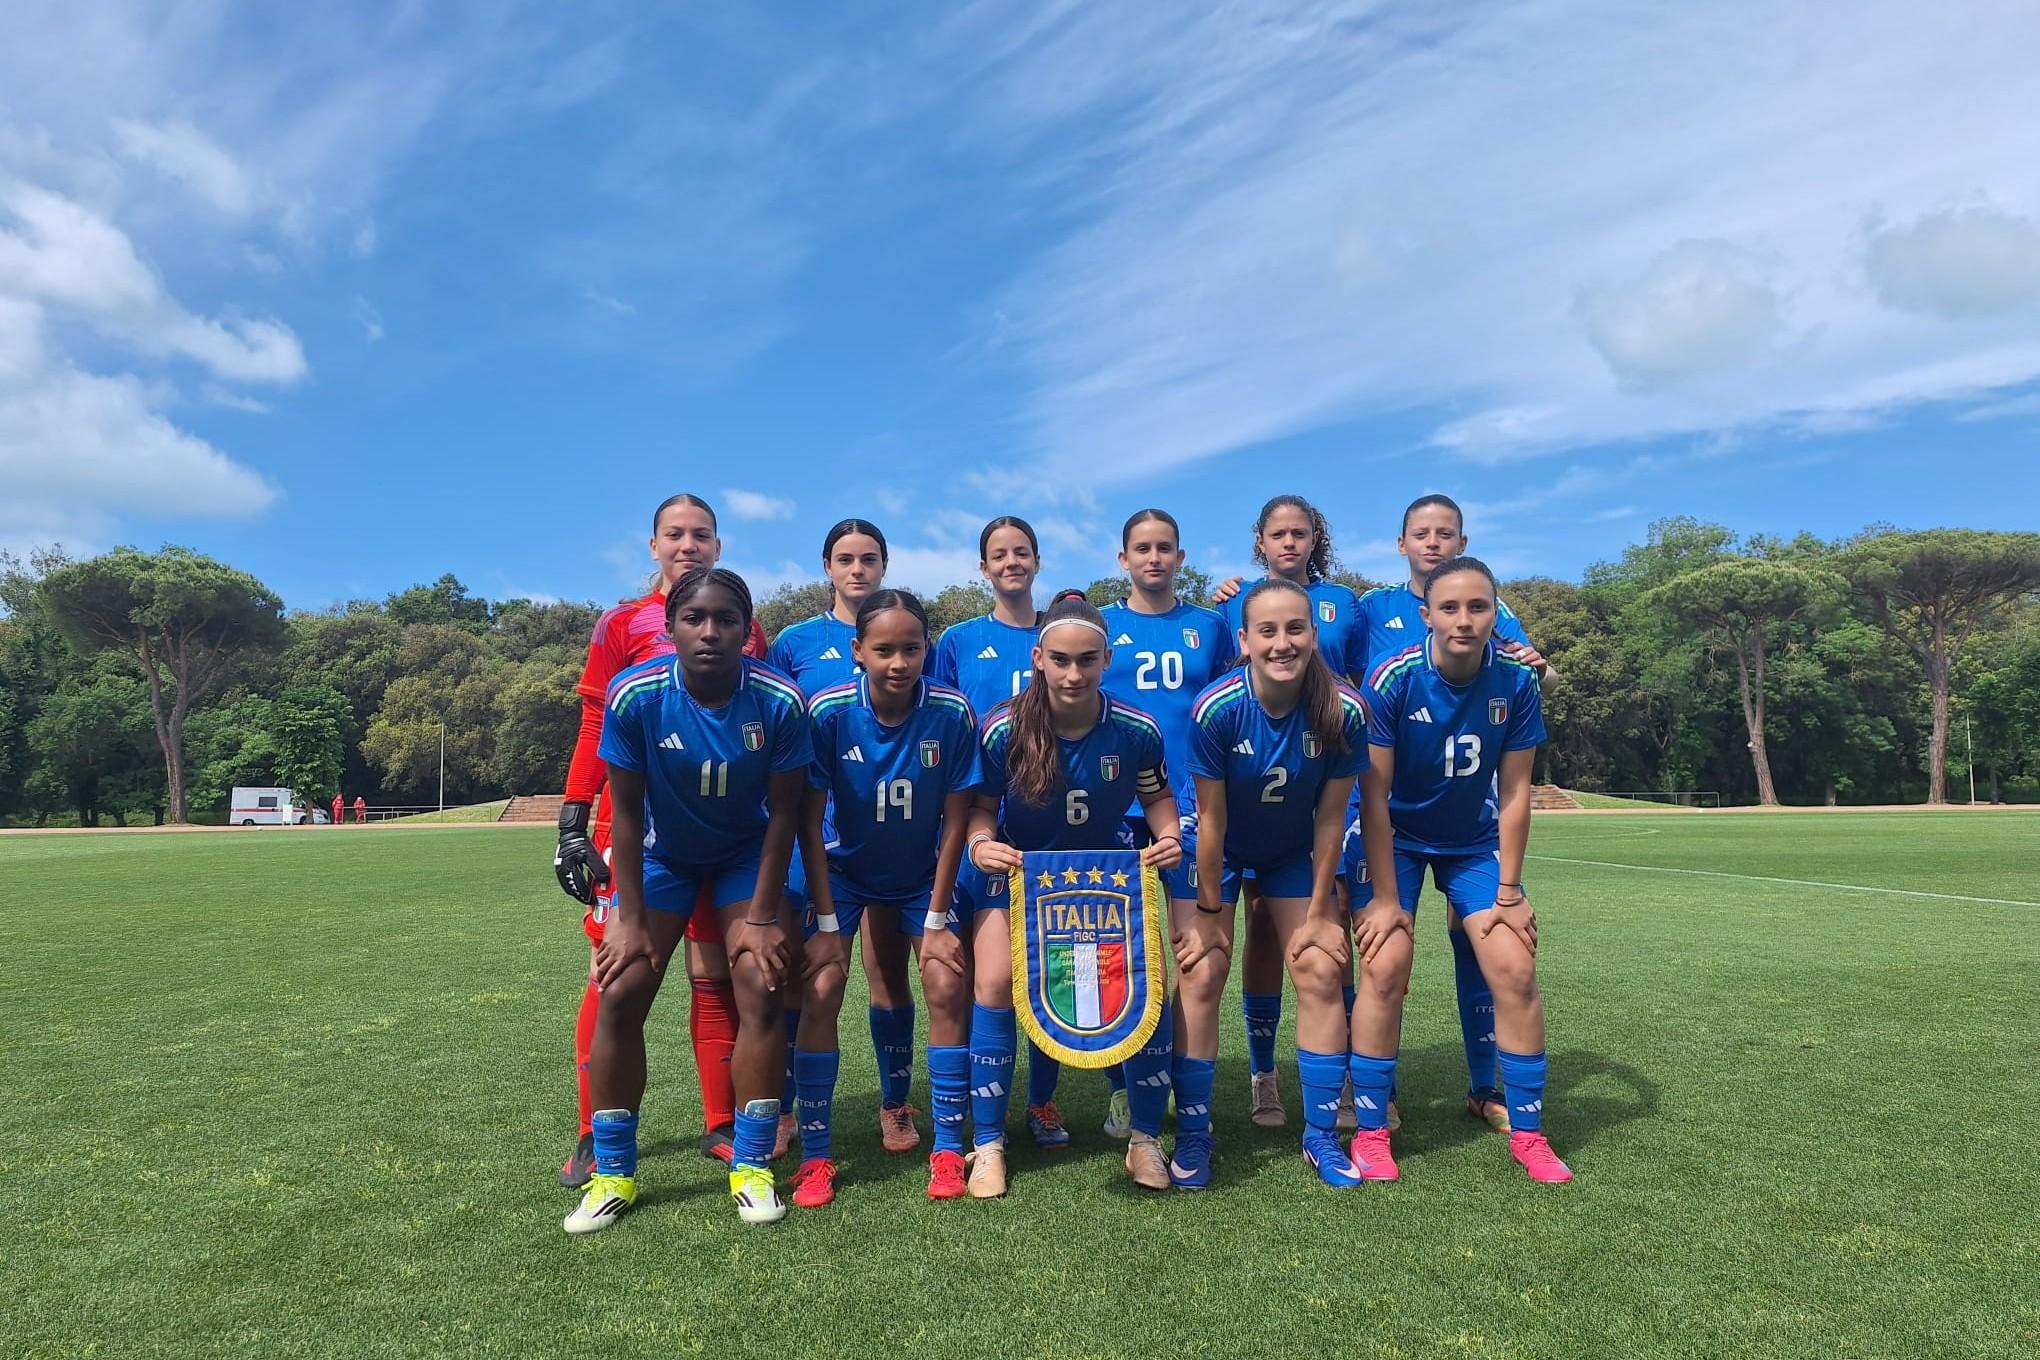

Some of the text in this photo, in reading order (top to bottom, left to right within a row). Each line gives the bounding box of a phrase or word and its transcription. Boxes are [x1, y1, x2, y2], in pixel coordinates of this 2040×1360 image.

[1012, 670, 1033, 697] 1
[1135, 651, 1184, 690] 20
[743, 724, 761, 733] ITALIA
[1444, 733, 1482, 778] 13
[700, 759, 728, 797] 11
[1260, 766, 1288, 803] 2
[876, 778, 913, 822] 19
[1066, 789, 1090, 826] 6
[1045, 903, 1122, 930] ITALIA
[1073, 931, 1096, 942] FIGC
[1475, 1005, 1495, 1013] ITA
[1139, 1042, 1172, 1055] TALIA
